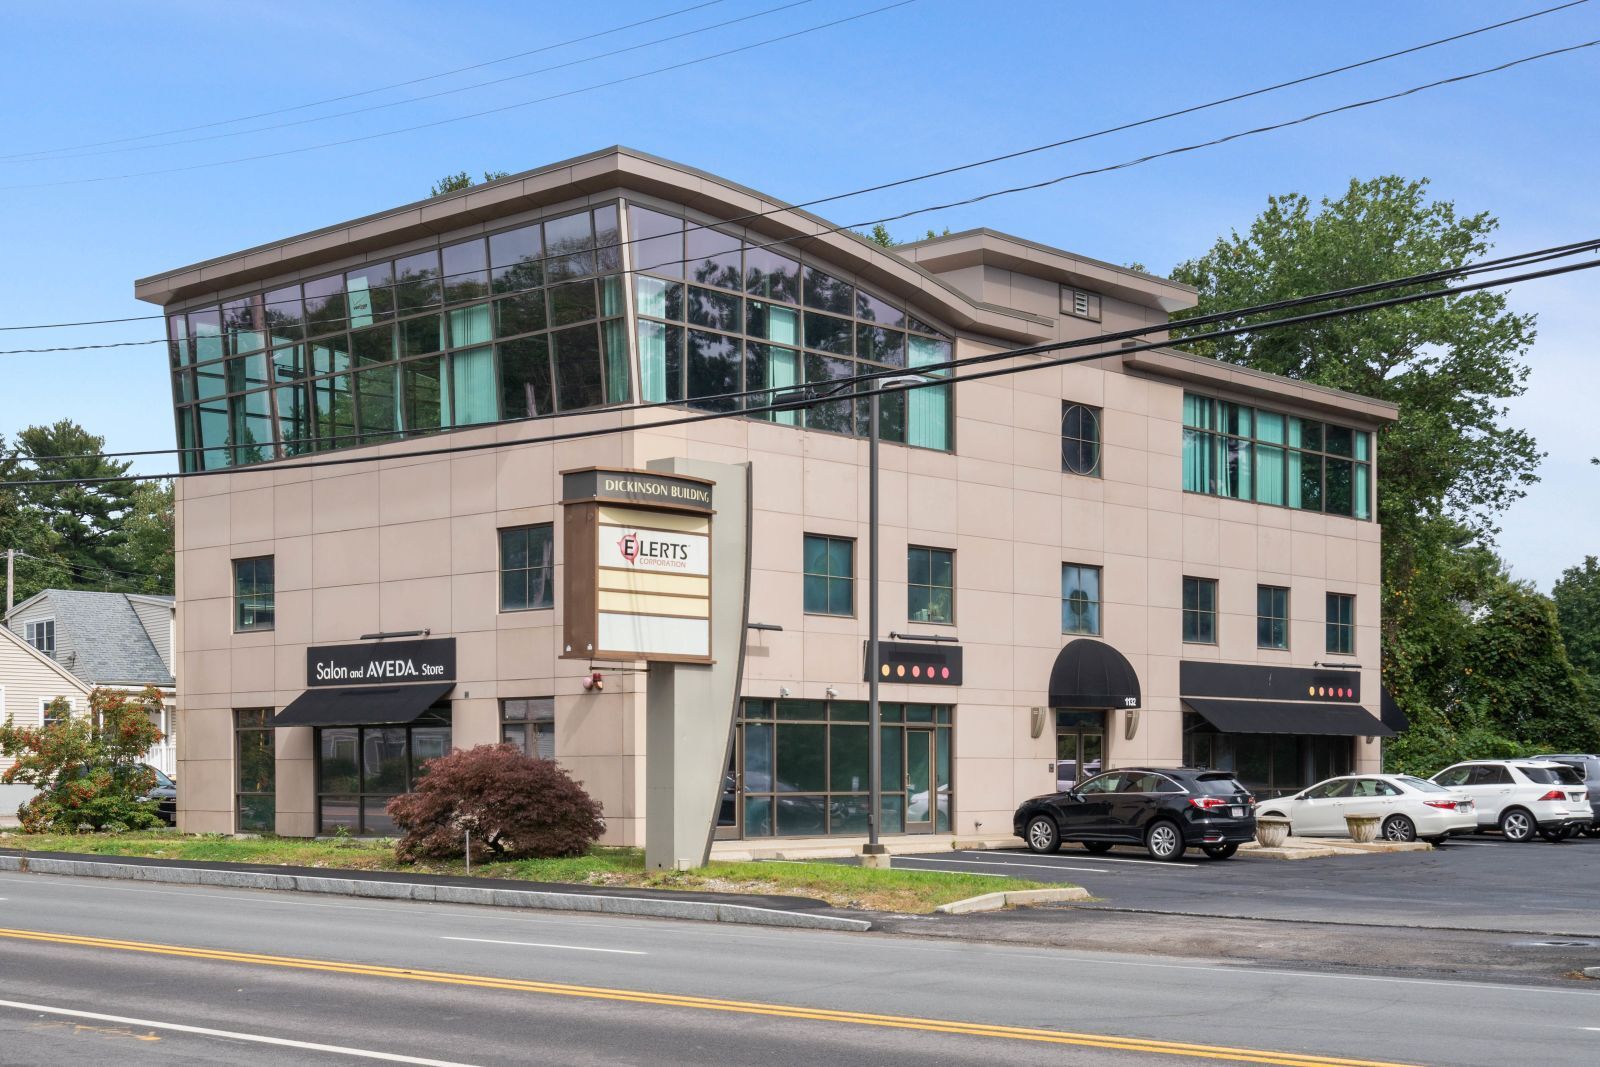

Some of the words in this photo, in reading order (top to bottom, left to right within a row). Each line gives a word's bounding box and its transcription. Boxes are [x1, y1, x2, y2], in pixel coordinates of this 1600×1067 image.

[605, 479, 668, 496] DICKINSON
[671, 485, 710, 503] BUILDING
[624, 539, 688, 560] ELERTS
[639, 557, 687, 568] CORPORATION
[316, 660, 348, 680] Salon
[349, 665, 364, 679] and
[421, 663, 444, 676] Store
[1124, 697, 1137, 706] 1132
